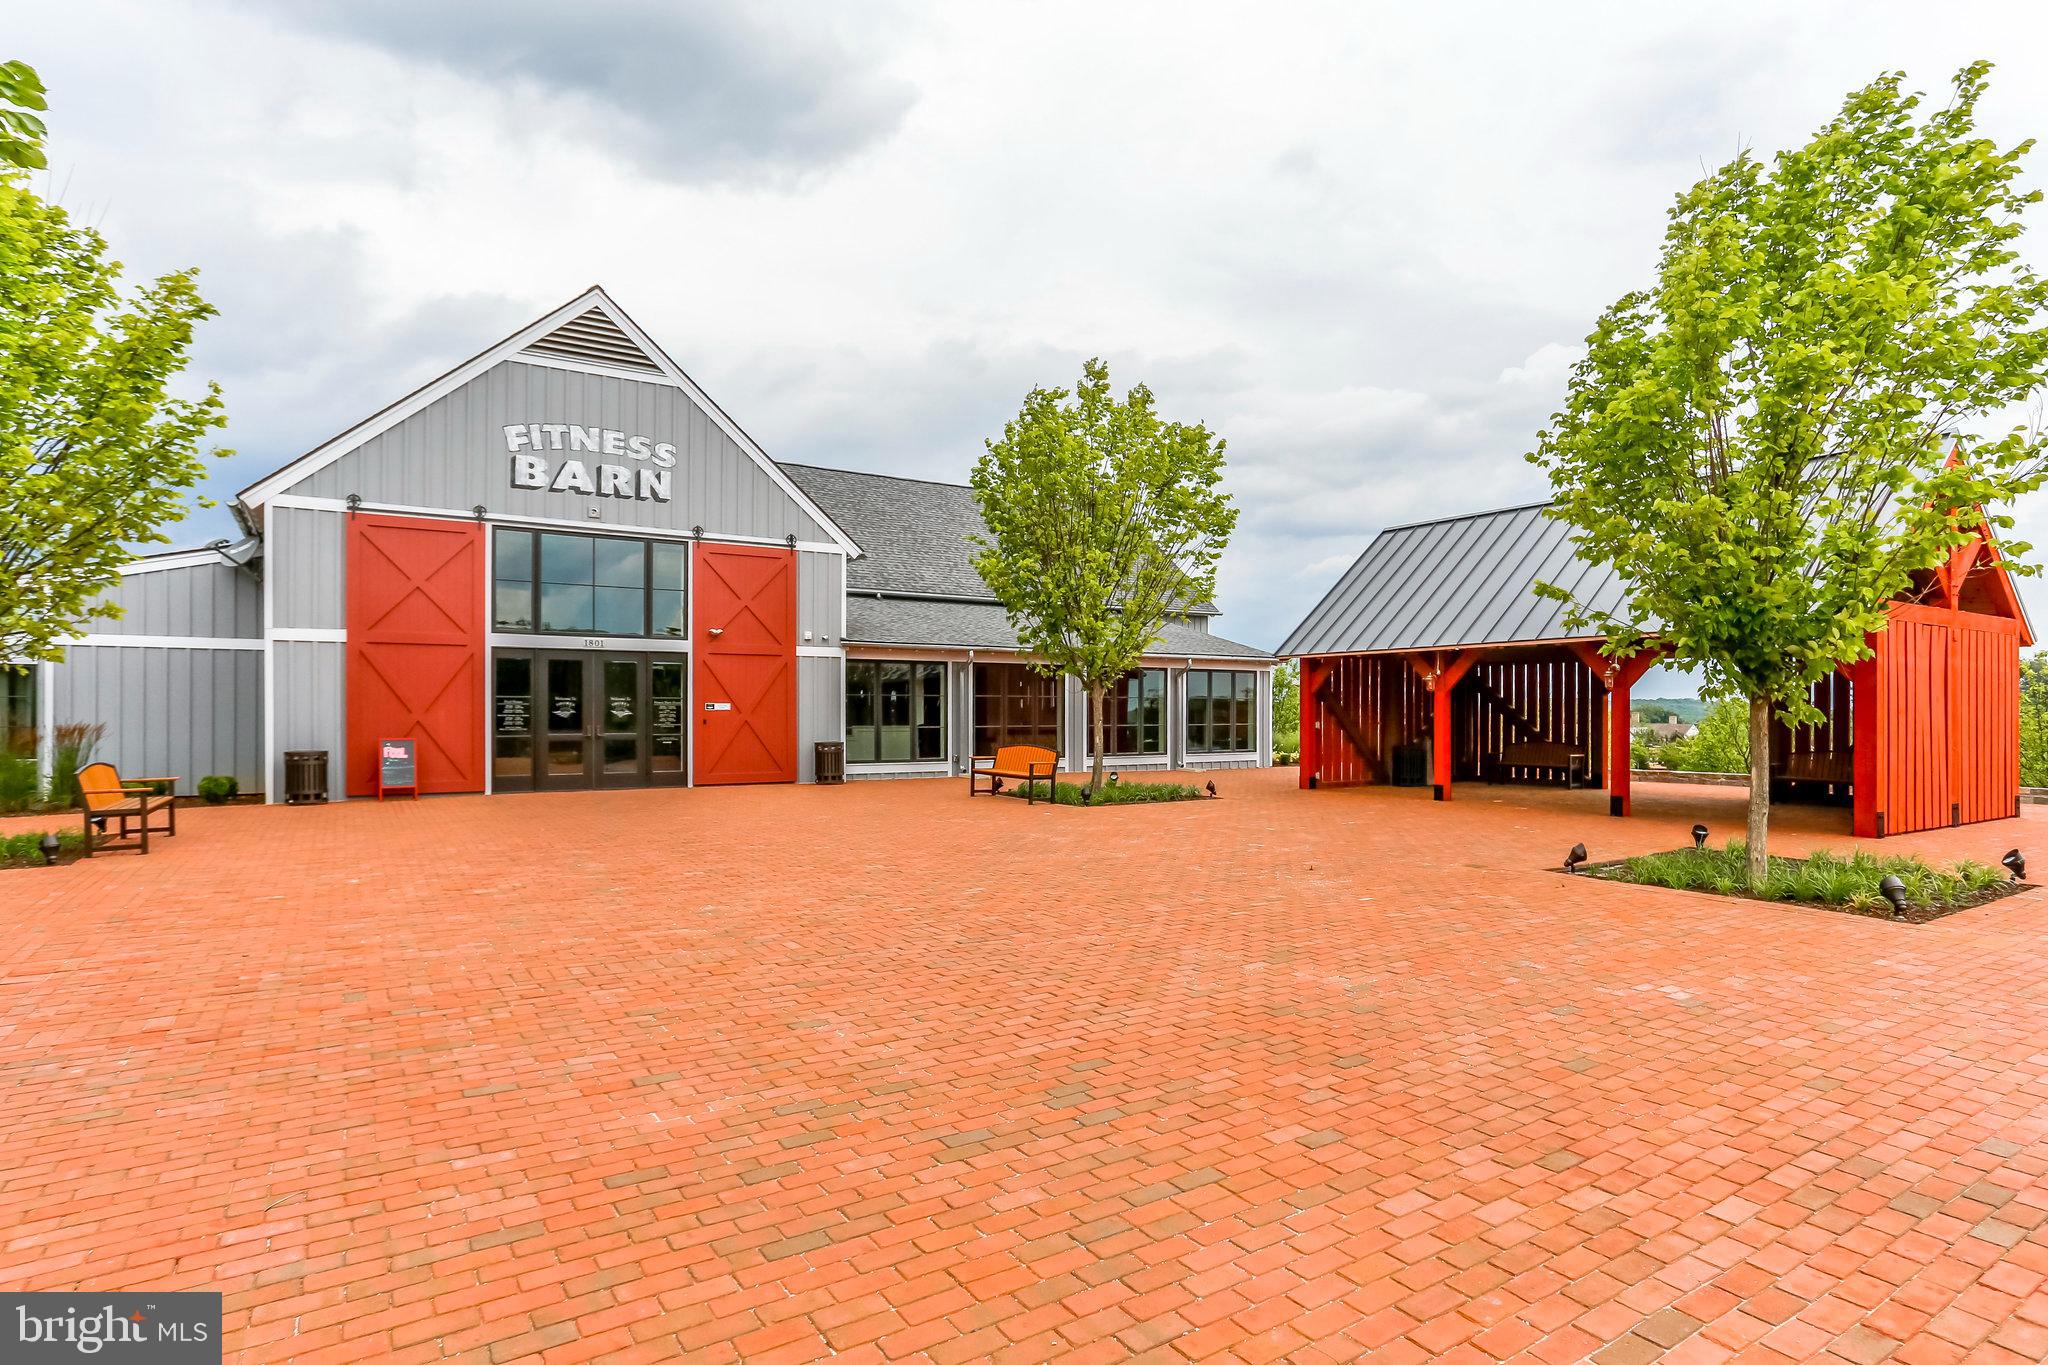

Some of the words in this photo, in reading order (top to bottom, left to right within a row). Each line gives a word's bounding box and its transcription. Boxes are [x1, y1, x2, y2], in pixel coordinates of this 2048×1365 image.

[503, 423, 677, 468] FITNESS
[511, 454, 672, 503] BARN
[584, 639, 604, 647] 1801
